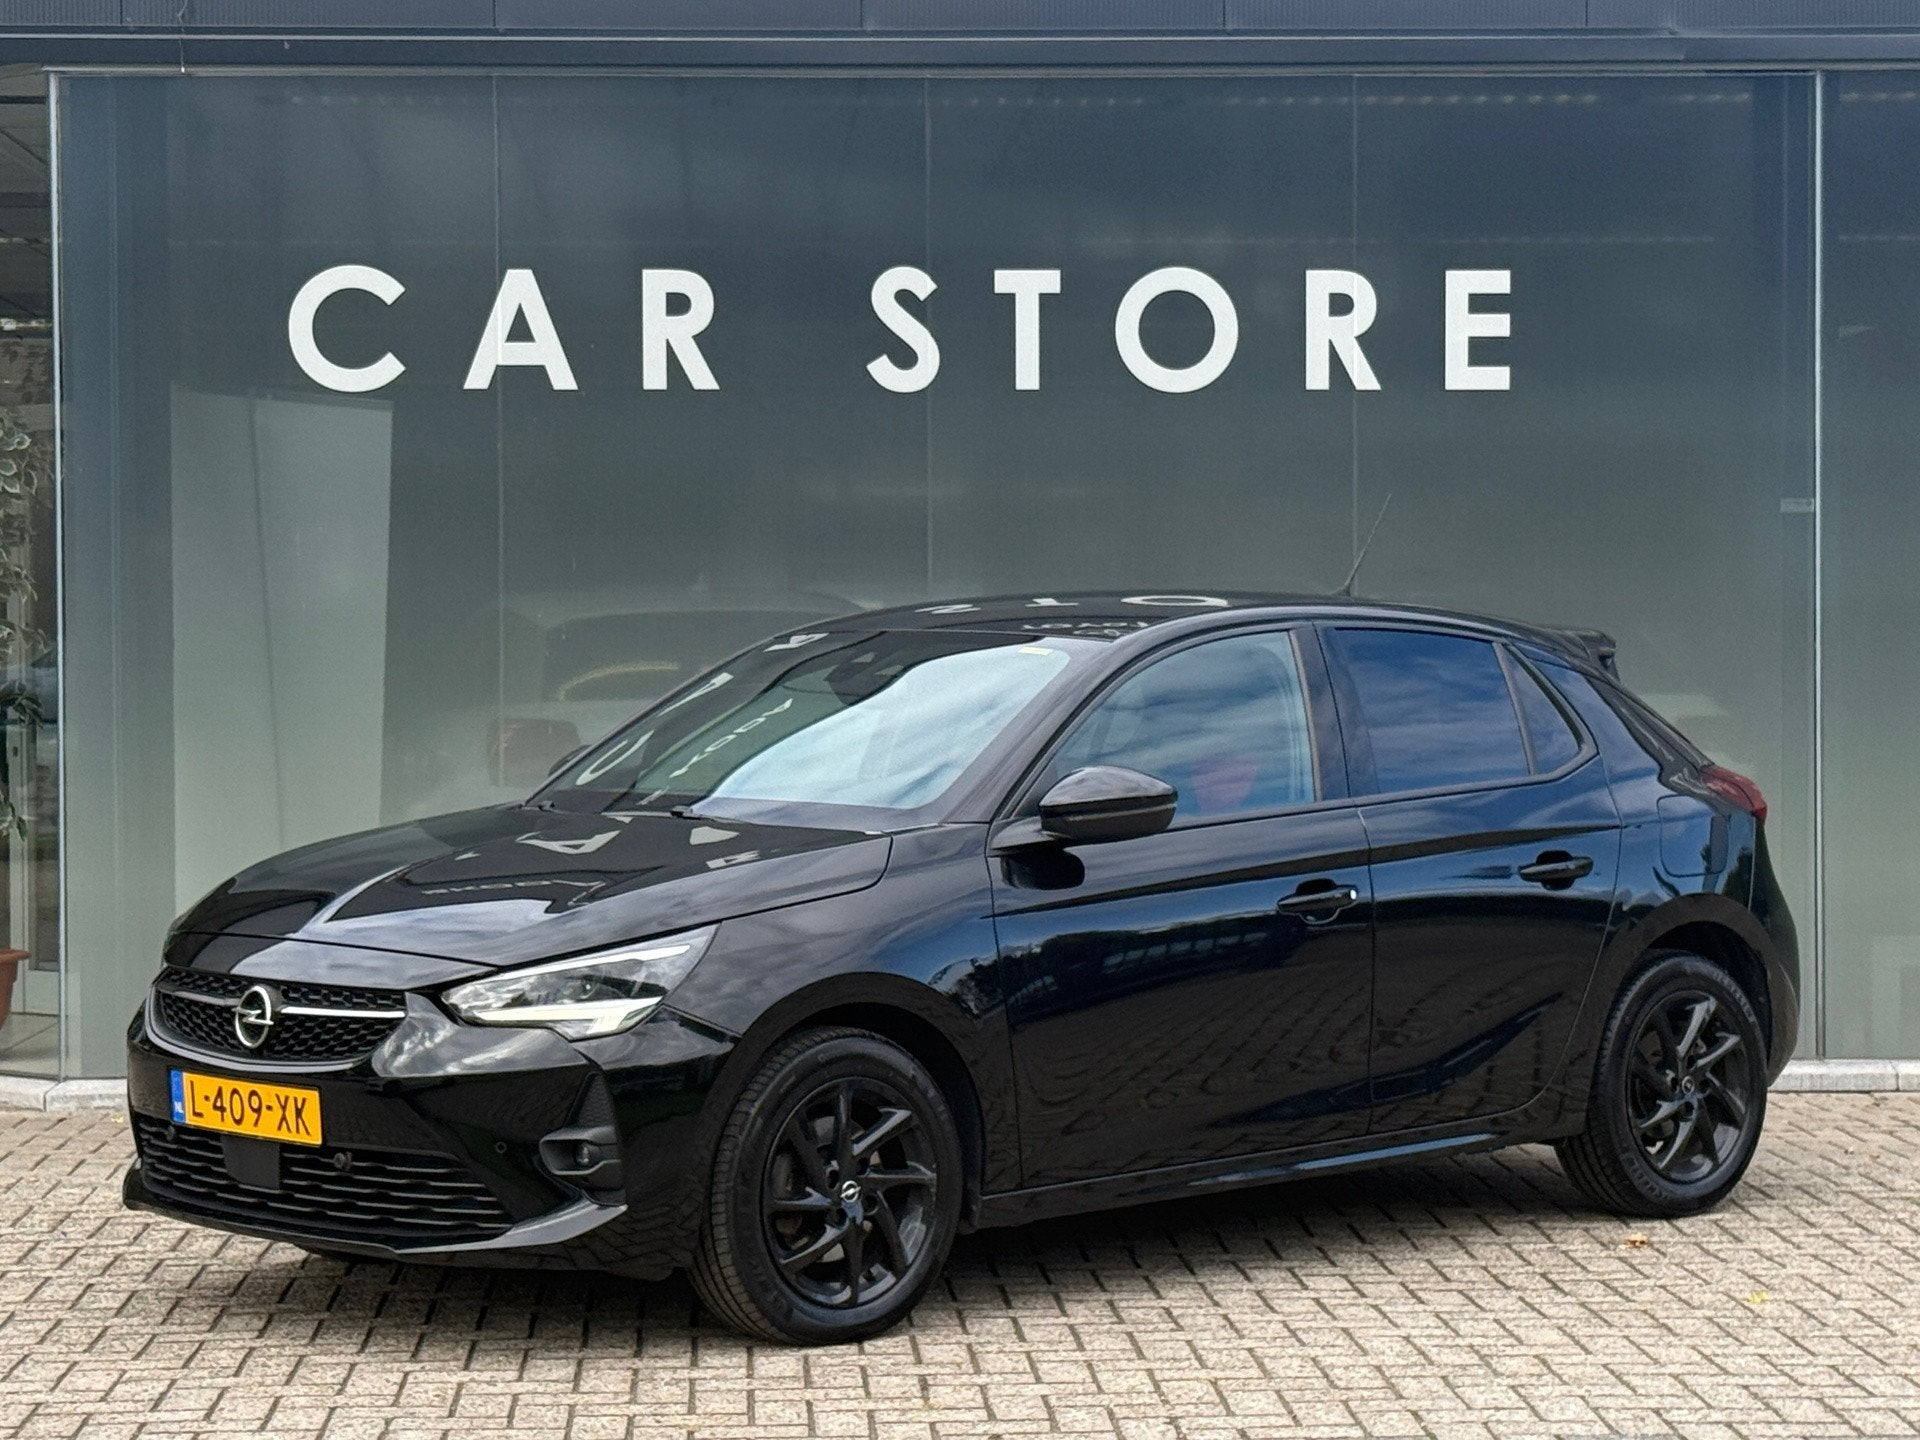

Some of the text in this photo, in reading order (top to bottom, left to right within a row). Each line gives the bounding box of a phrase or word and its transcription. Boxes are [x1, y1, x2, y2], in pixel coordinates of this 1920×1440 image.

[288, 264, 1512, 393] CAR STORE
[189, 1079, 312, 1137] L-409-XK
